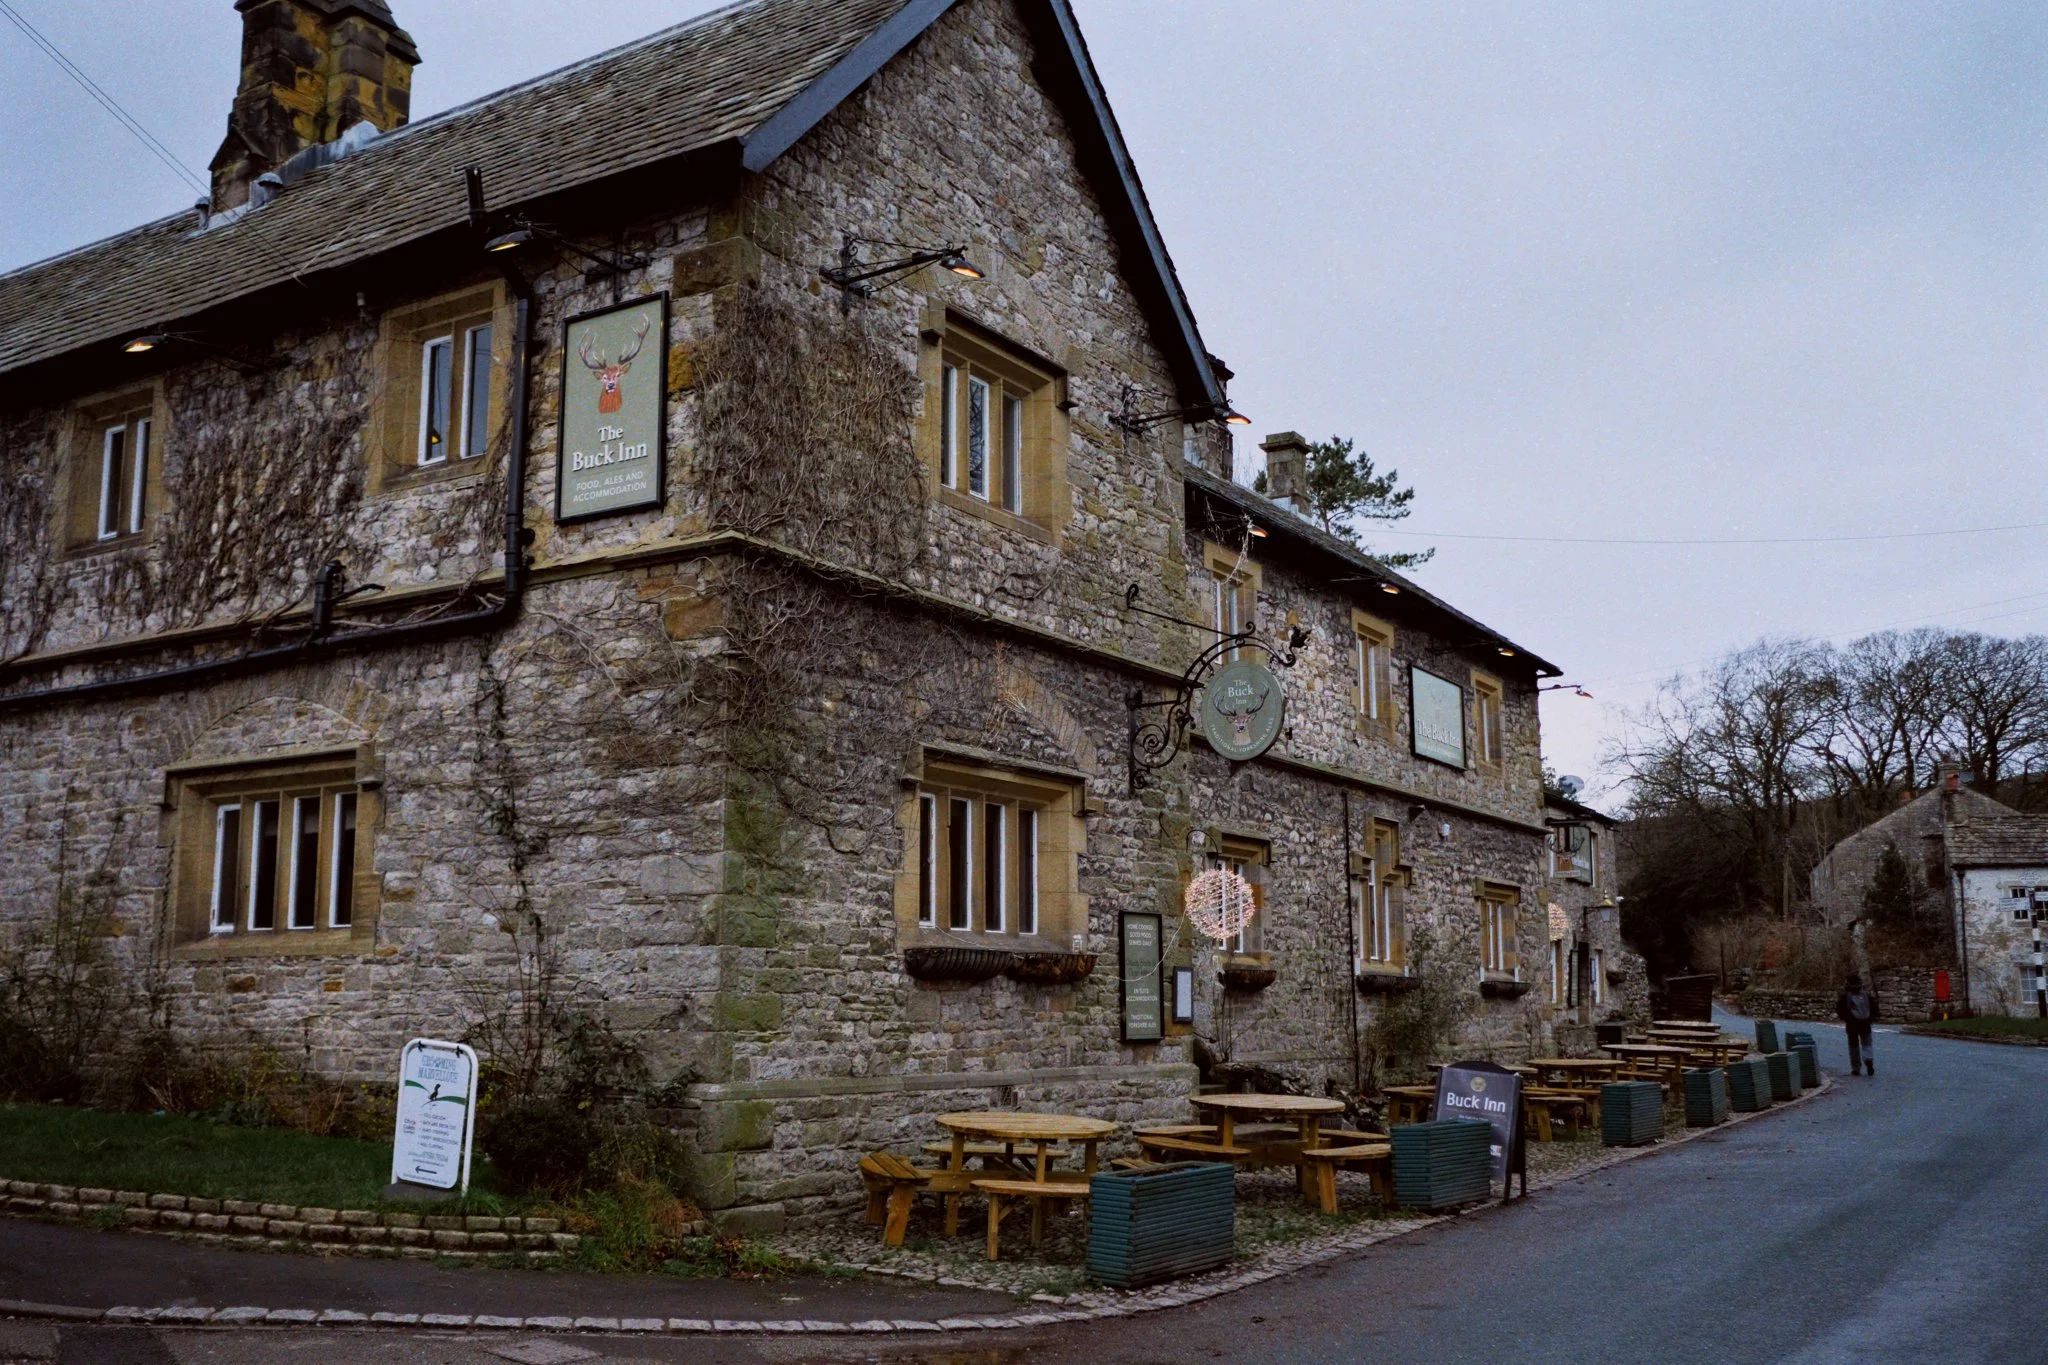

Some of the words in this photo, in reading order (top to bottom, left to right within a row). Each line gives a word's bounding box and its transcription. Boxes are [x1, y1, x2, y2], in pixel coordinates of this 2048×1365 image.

[598, 425, 624, 442] The
[572, 444, 614, 472] Buck
[618, 442, 649, 462] Inn
[604, 475, 623, 486] ALES
[625, 471, 644, 482] AND
[572, 481, 647, 502] ACCOMMODATION
[1228, 684, 1254, 697] Buck
[1417, 719, 1431, 738] The
[1431, 724, 1448, 744] Buck
[1446, 1092, 1480, 1110] Buck
[1484, 1097, 1506, 1113] Inn
